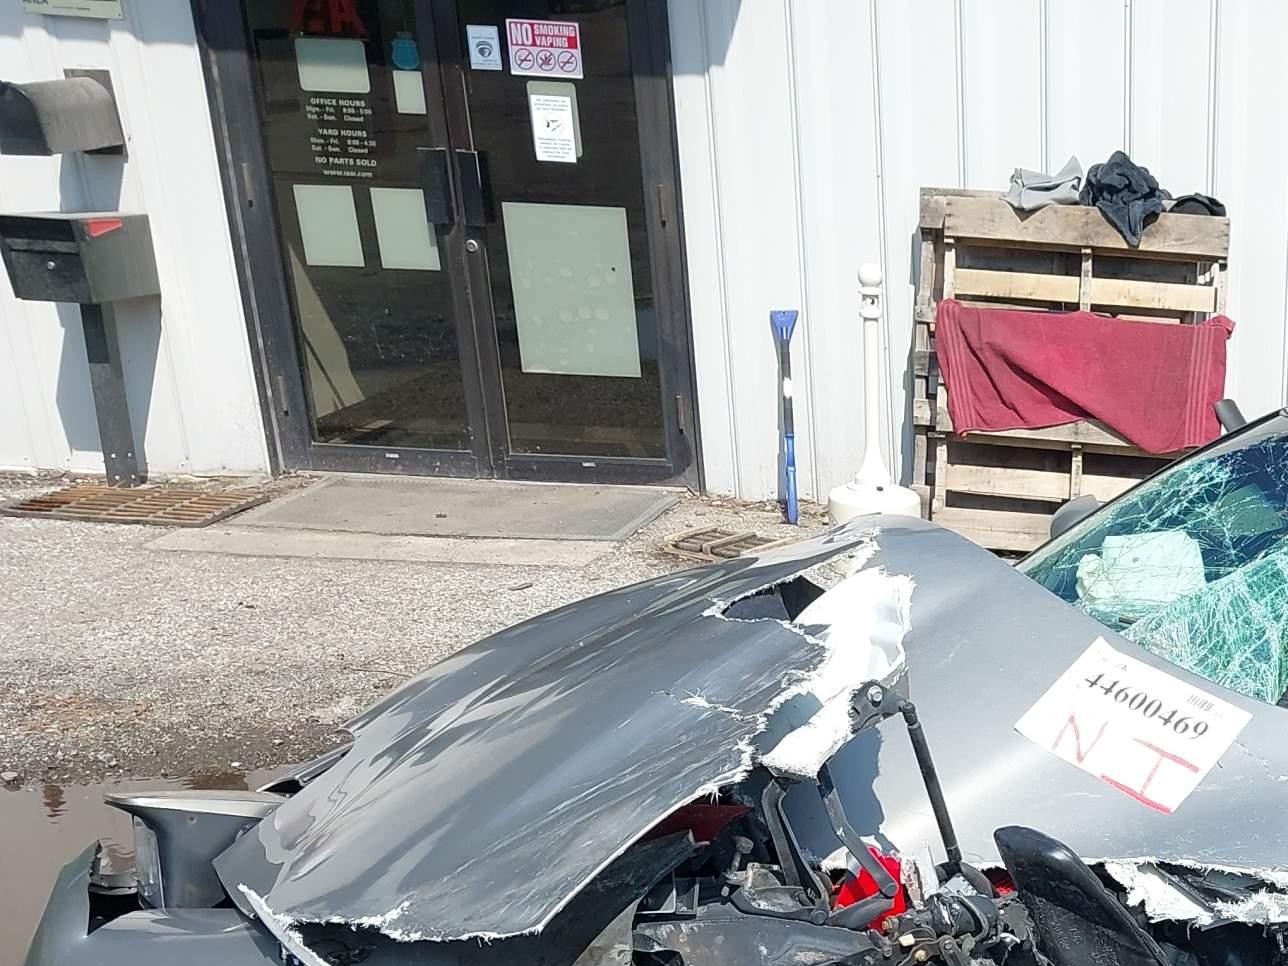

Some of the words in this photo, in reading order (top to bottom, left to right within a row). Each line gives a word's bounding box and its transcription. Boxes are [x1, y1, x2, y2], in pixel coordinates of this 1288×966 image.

[510, 23, 533, 46] NO
[534, 24, 575, 37] SMOKING
[535, 37, 569, 48] VAPING
[310, 98, 337, 106] OFFICE
[339, 99, 366, 107] HOURS
[318, 128, 339, 136] YARD
[340, 129, 367, 137] HOURS
[329, 157, 354, 165] PARTS
[356, 158, 377, 166] SOLD
[1084, 673, 1209, 740] 44600469
